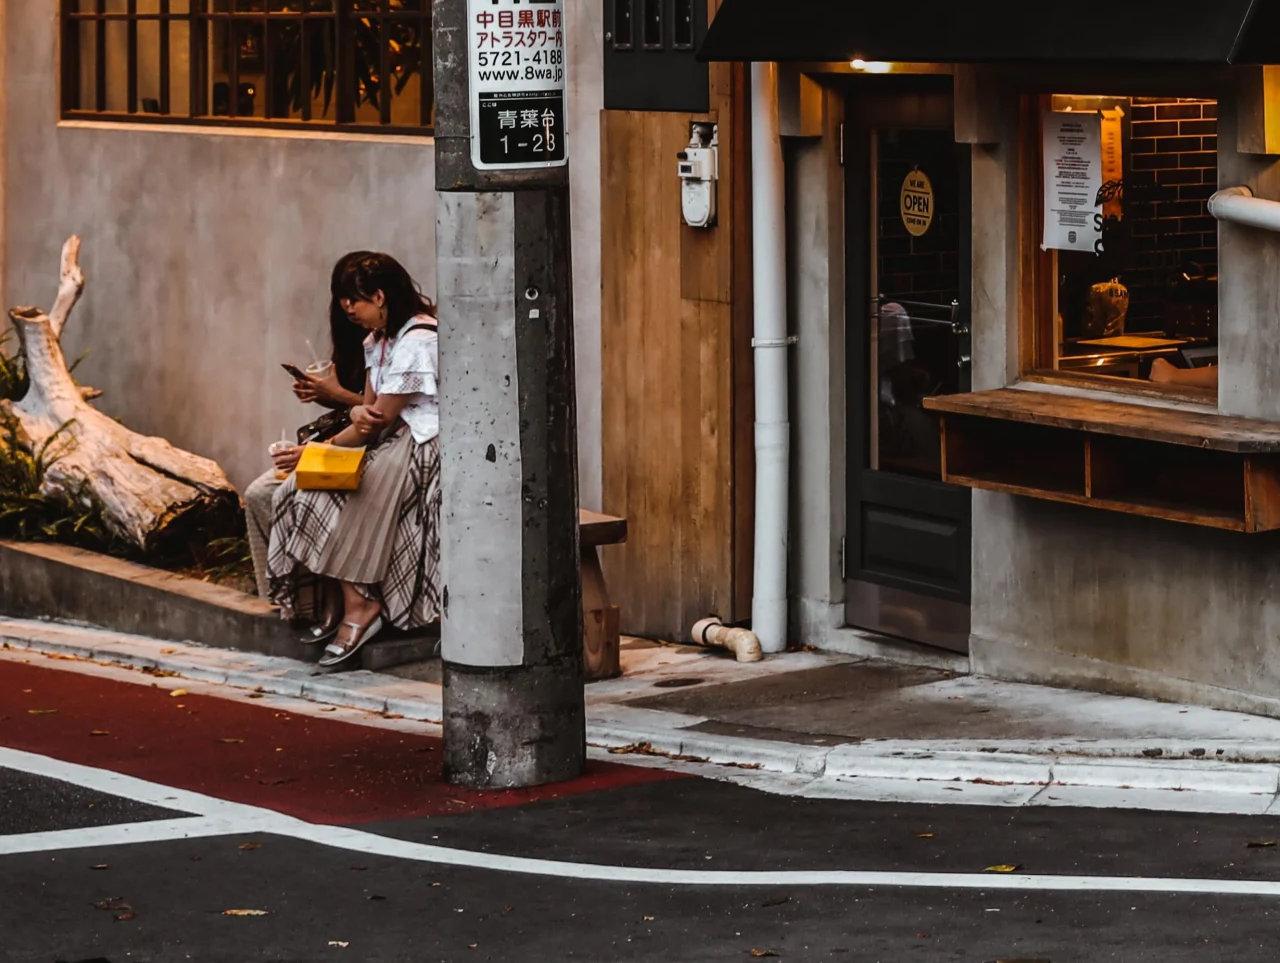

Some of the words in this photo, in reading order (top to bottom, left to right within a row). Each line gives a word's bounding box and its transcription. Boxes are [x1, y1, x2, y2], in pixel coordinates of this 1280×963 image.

[476, 9, 562, 29] 中目黒駅前
[476, 31, 562, 49] アトラスタワー内
[478, 49, 563, 66] 5721-4188
[478, 66, 563, 82] www.8wa.jp
[497, 108, 555, 129] 青葉台
[500, 133, 556, 154] 1-23
[904, 194, 929, 213] OPEN
